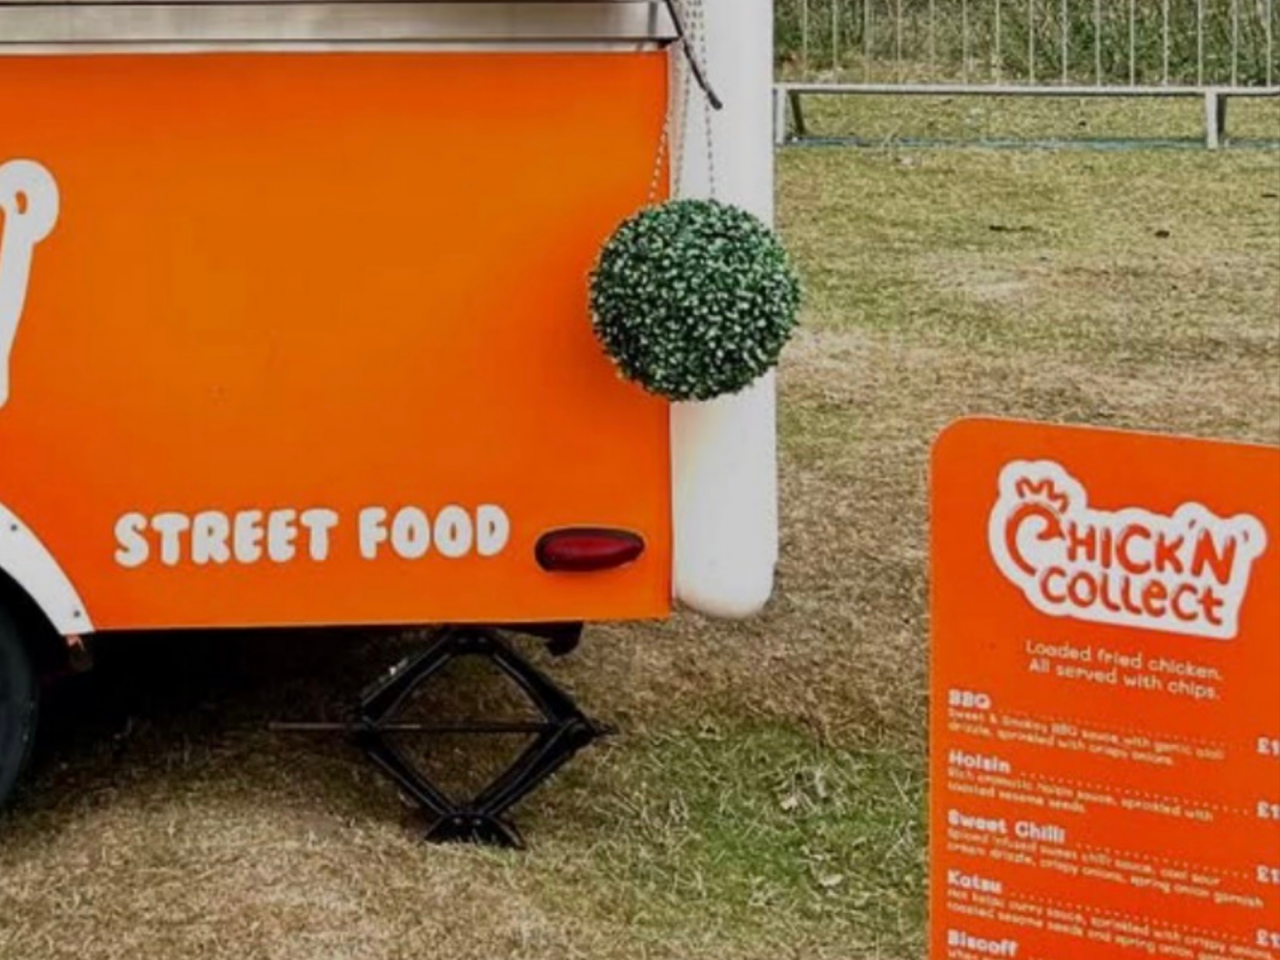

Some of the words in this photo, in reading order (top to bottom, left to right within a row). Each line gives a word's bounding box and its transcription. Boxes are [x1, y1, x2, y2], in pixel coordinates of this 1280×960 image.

[114, 508, 339, 567] STREET
[359, 504, 510, 558] FOOD
[1026, 640, 1092, 662] Loaded
[1097, 648, 1143, 670] fried
[1148, 655, 1224, 682] chicken.
[1028, 659, 1050, 674] All
[1056, 663, 1118, 685] served
[1123, 671, 1162, 690] with
[1168, 678, 1220, 700] chips.
[948, 689, 991, 709] BBQ
[948, 749, 1011, 774] Hoisin
[948, 809, 1007, 834] Sweet
[1014, 820, 1065, 844] Chilli
[1184, 807, 1213, 821] with
[948, 869, 1003, 894] Katsu
[948, 929, 1018, 958] Biscoff
